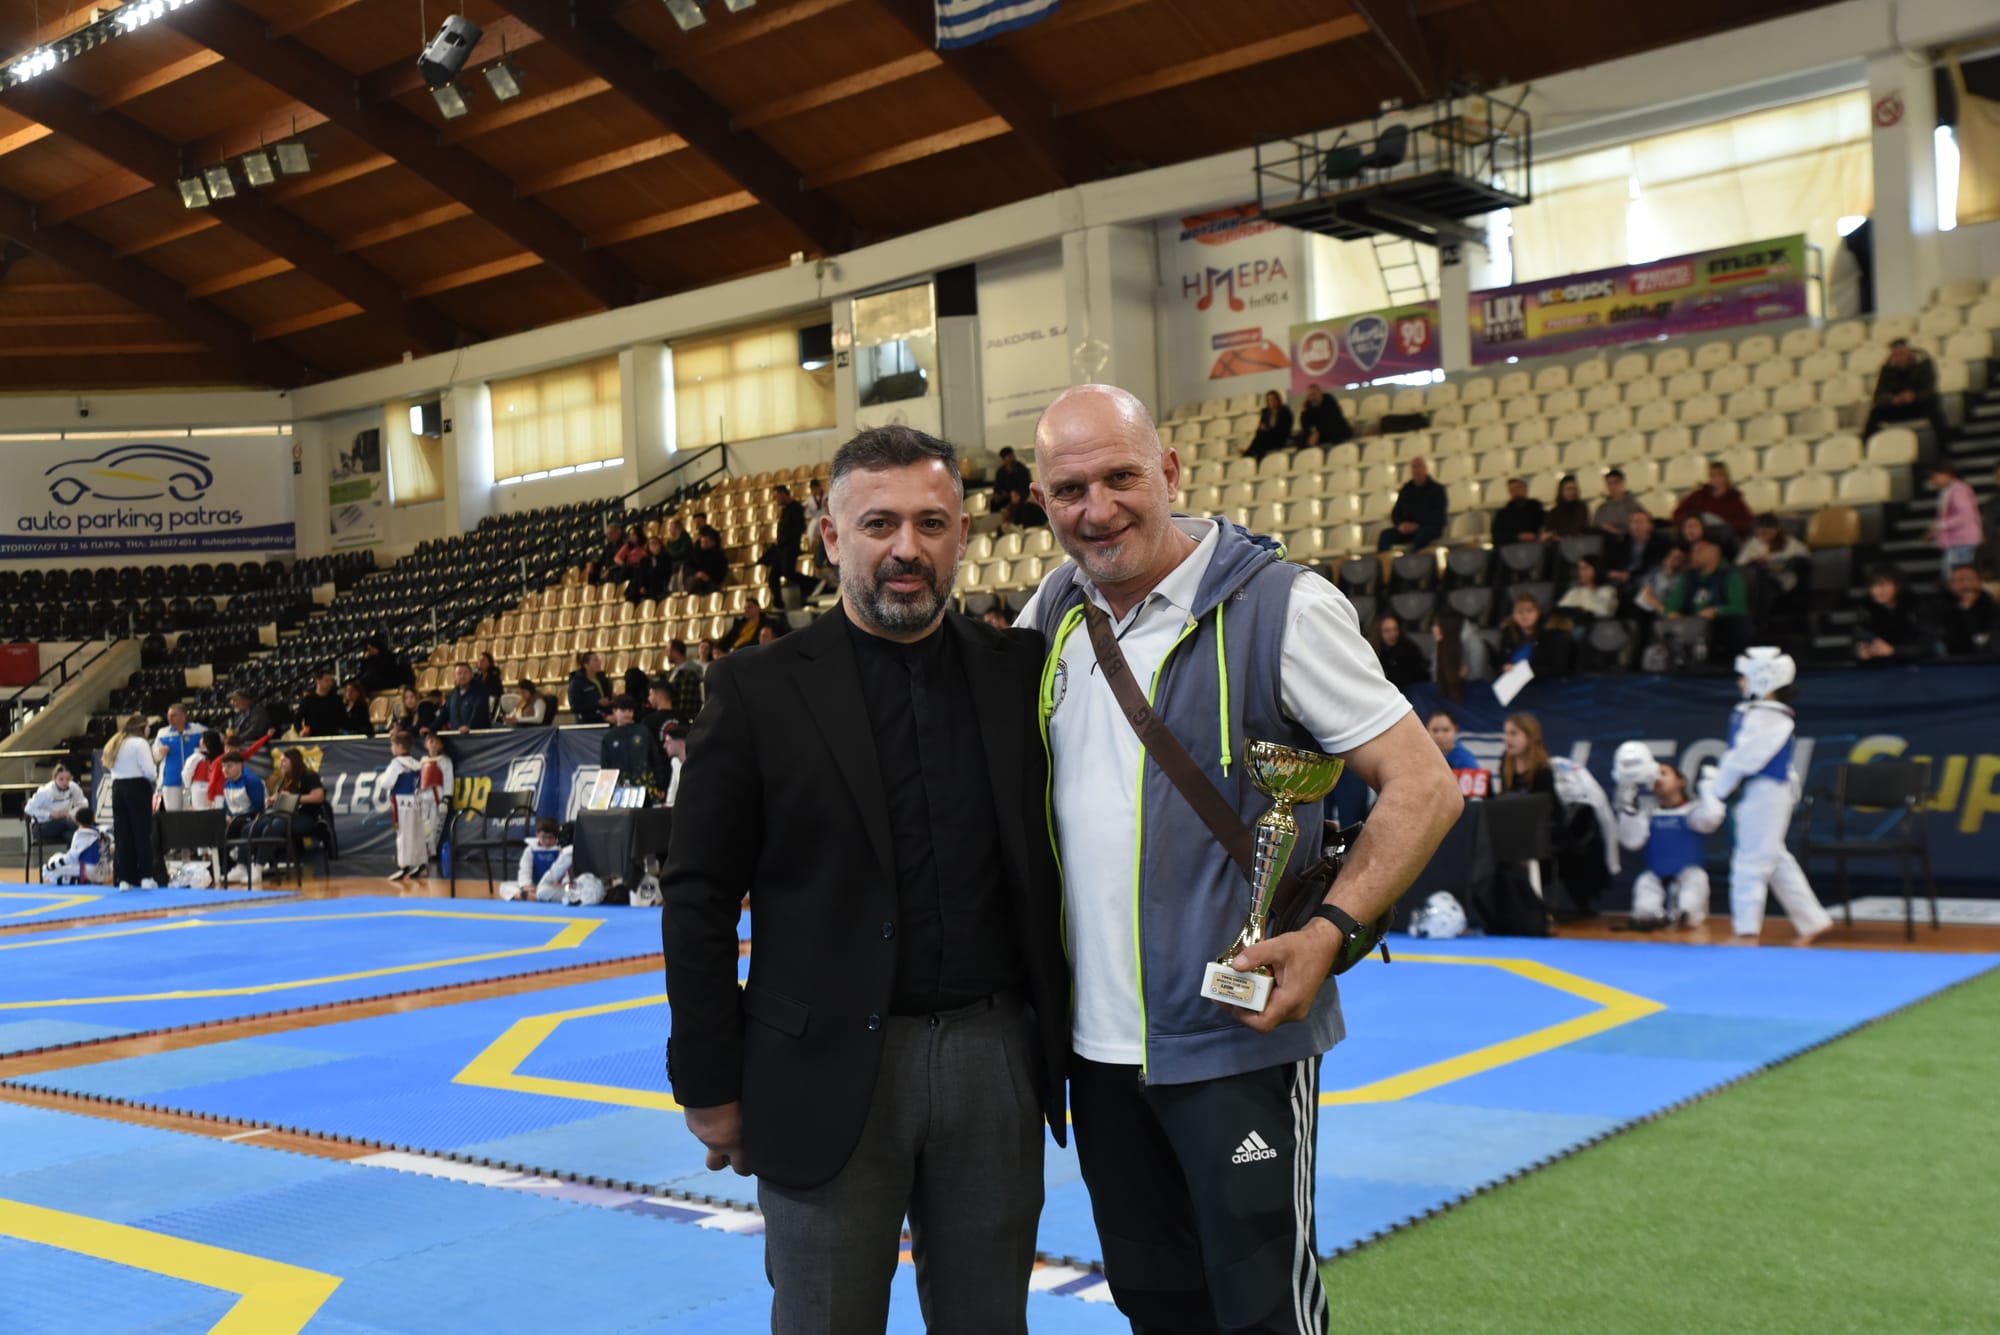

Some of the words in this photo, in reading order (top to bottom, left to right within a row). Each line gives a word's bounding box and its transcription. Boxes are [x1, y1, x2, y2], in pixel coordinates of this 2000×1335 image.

[17, 509, 72, 531] auto
[77, 507, 163, 535] parking
[169, 505, 243, 531] patras
[91, 540, 121, 550] ΠΑΤΡΑ
[1231, 1147, 1278, 1164] adidas
